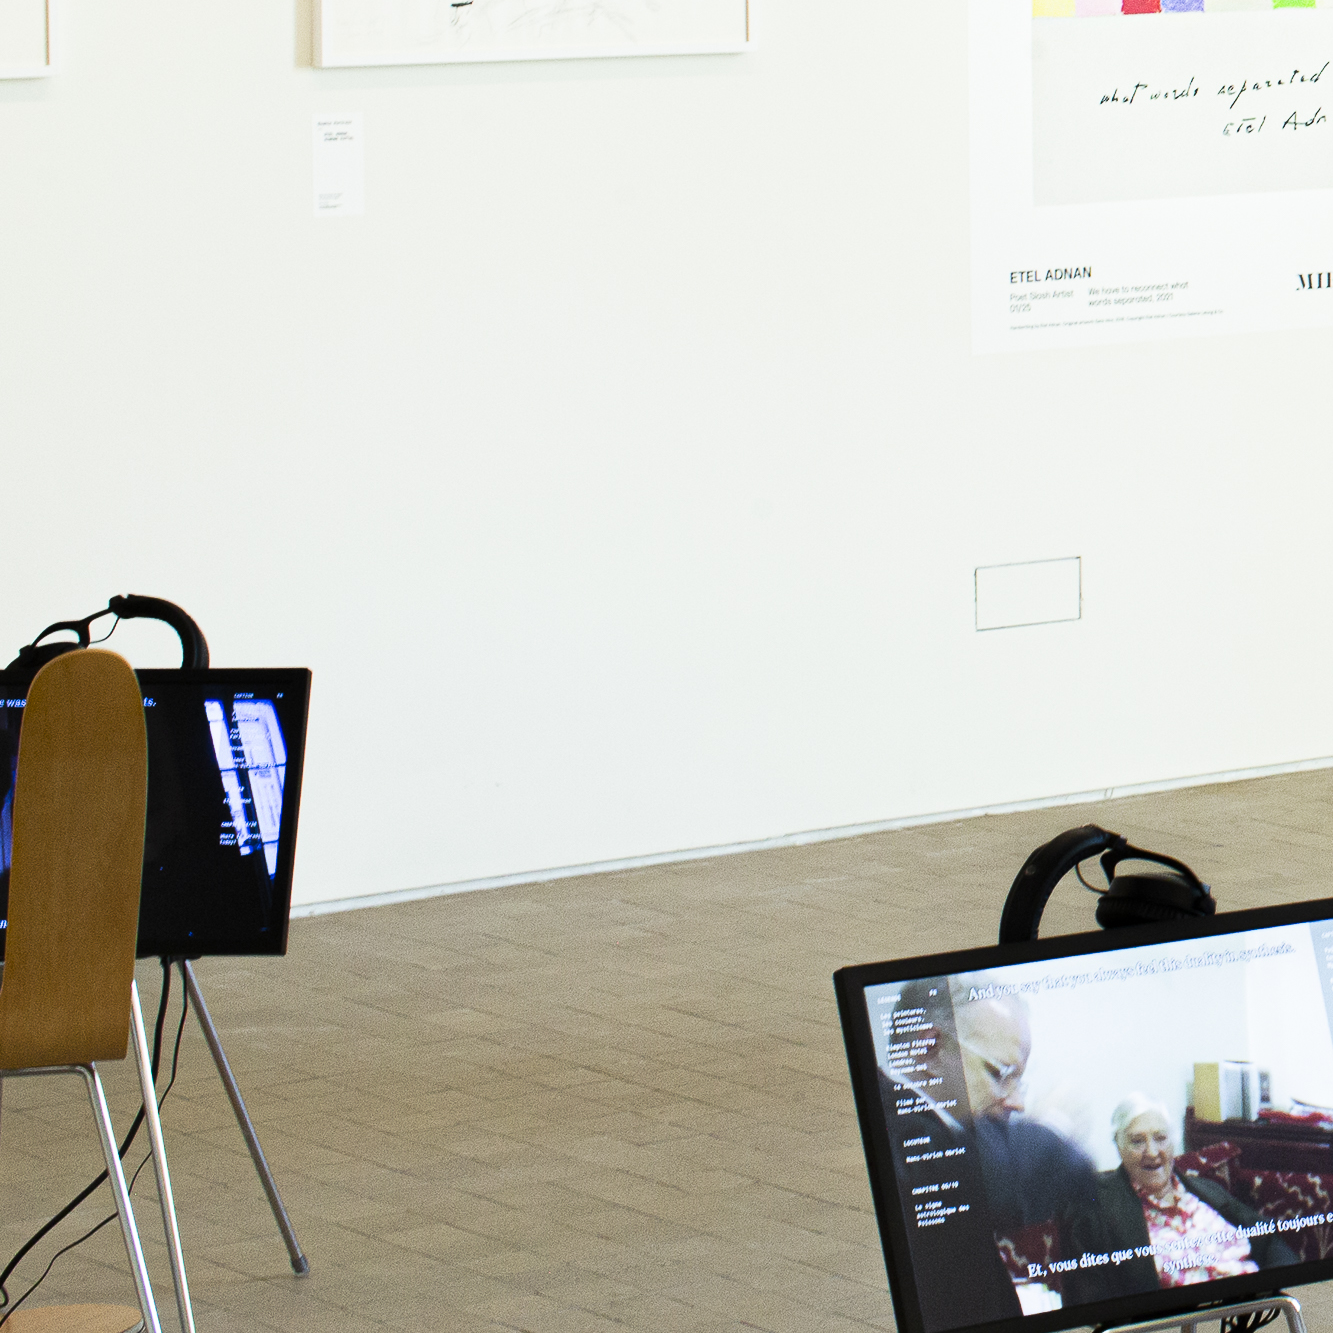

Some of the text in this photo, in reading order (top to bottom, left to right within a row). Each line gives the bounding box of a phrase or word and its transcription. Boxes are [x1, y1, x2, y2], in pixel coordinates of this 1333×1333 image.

[1217, 61, 1330, 110] separated
[1009, 266, 1093, 284] ETEL ADNAN
[968, 984, 995, 1002] And
[1027, 1261, 1048, 1280] Et,
[1048, 1257, 1078, 1274] vous
[1079, 1250, 1110, 1269] dites
[1111, 1248, 1134, 1268] que
[1235, 1218, 1276, 1241] dualité
[1276, 1211, 1325, 1238] toujours
